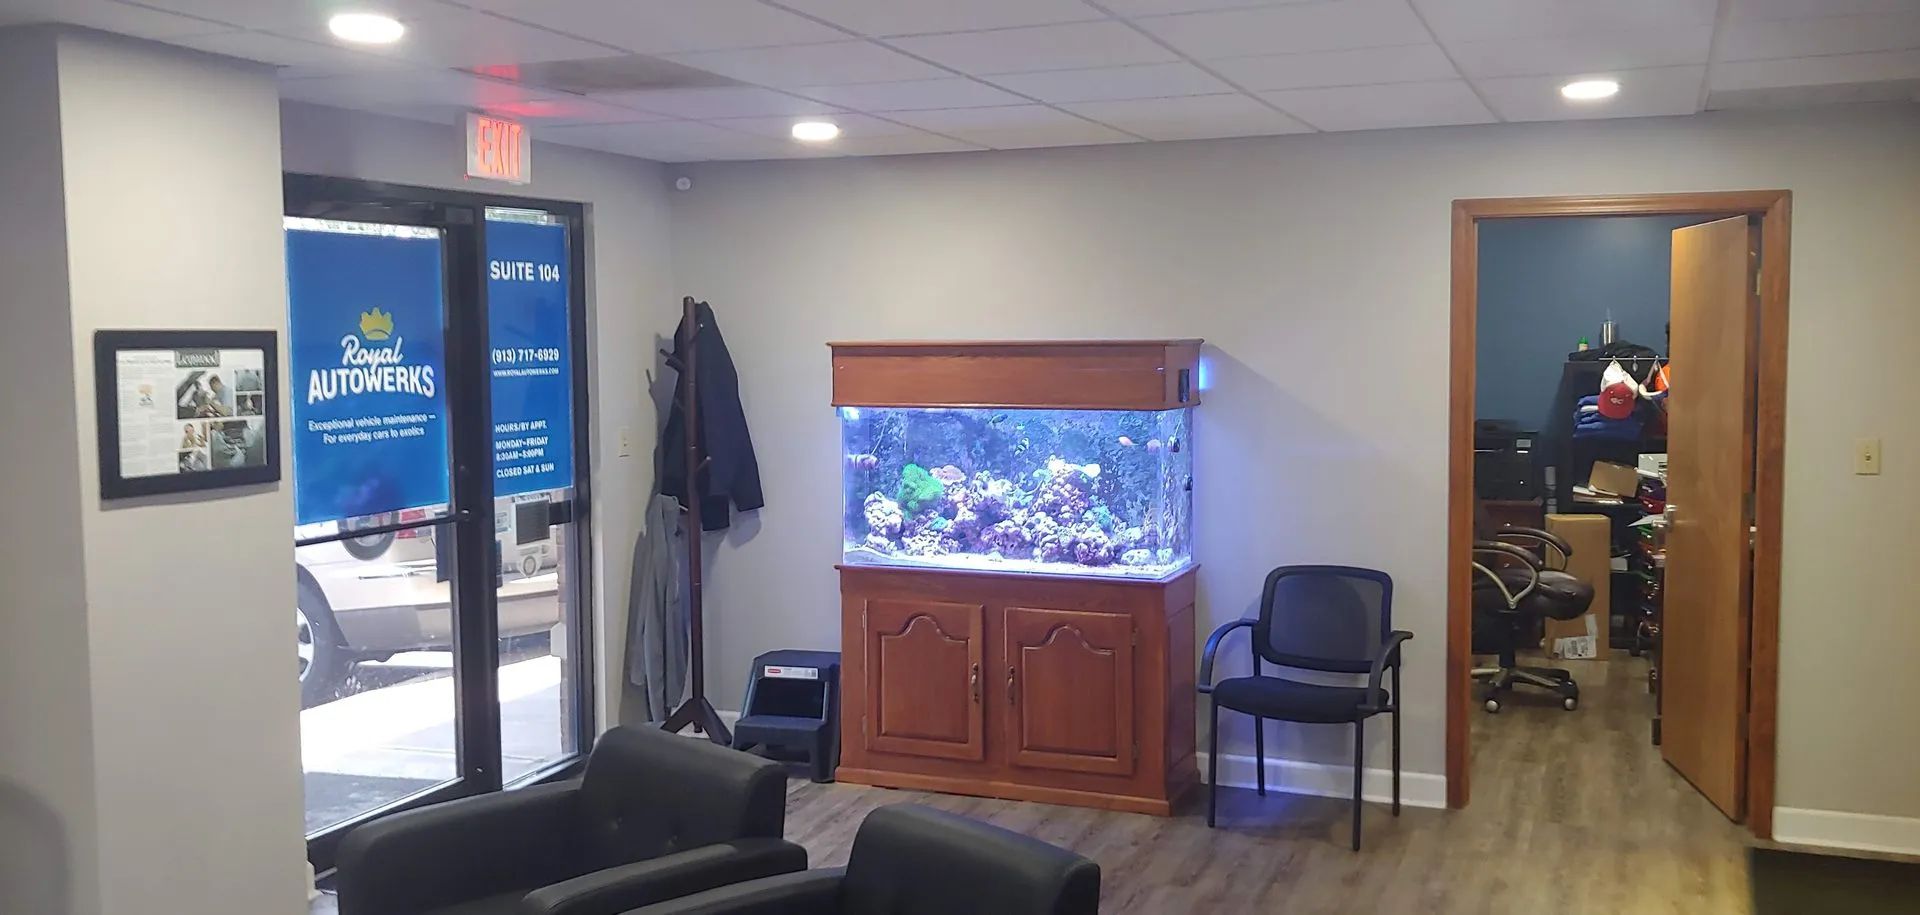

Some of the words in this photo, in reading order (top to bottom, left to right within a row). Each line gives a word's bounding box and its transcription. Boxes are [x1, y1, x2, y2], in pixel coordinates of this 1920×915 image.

[478, 117, 521, 177] EXIT
[490, 260, 534, 281] SUITE
[538, 263, 560, 282] 104
[341, 334, 404, 376] Royal
[492, 348, 516, 364] (913)
[518, 348, 559, 361] 717-6929
[307, 365, 435, 405] AUTOWERKS
[308, 419, 354, 432] Exceptional
[355, 416, 381, 427] vehicle
[382, 413, 427, 425] maintenance
[495, 421, 529, 433] HOURS/BY
[323, 433, 337, 444] For
[338, 431, 371, 443] everyday
[372, 430, 389, 440] cars
[390, 428, 398, 438] to
[399, 426, 425, 437] exotics
[496, 466, 522, 478] CLOSED
[523, 464, 534, 475] SAT
[535, 465, 540, 473] &
[541, 462, 555, 473] SUN
